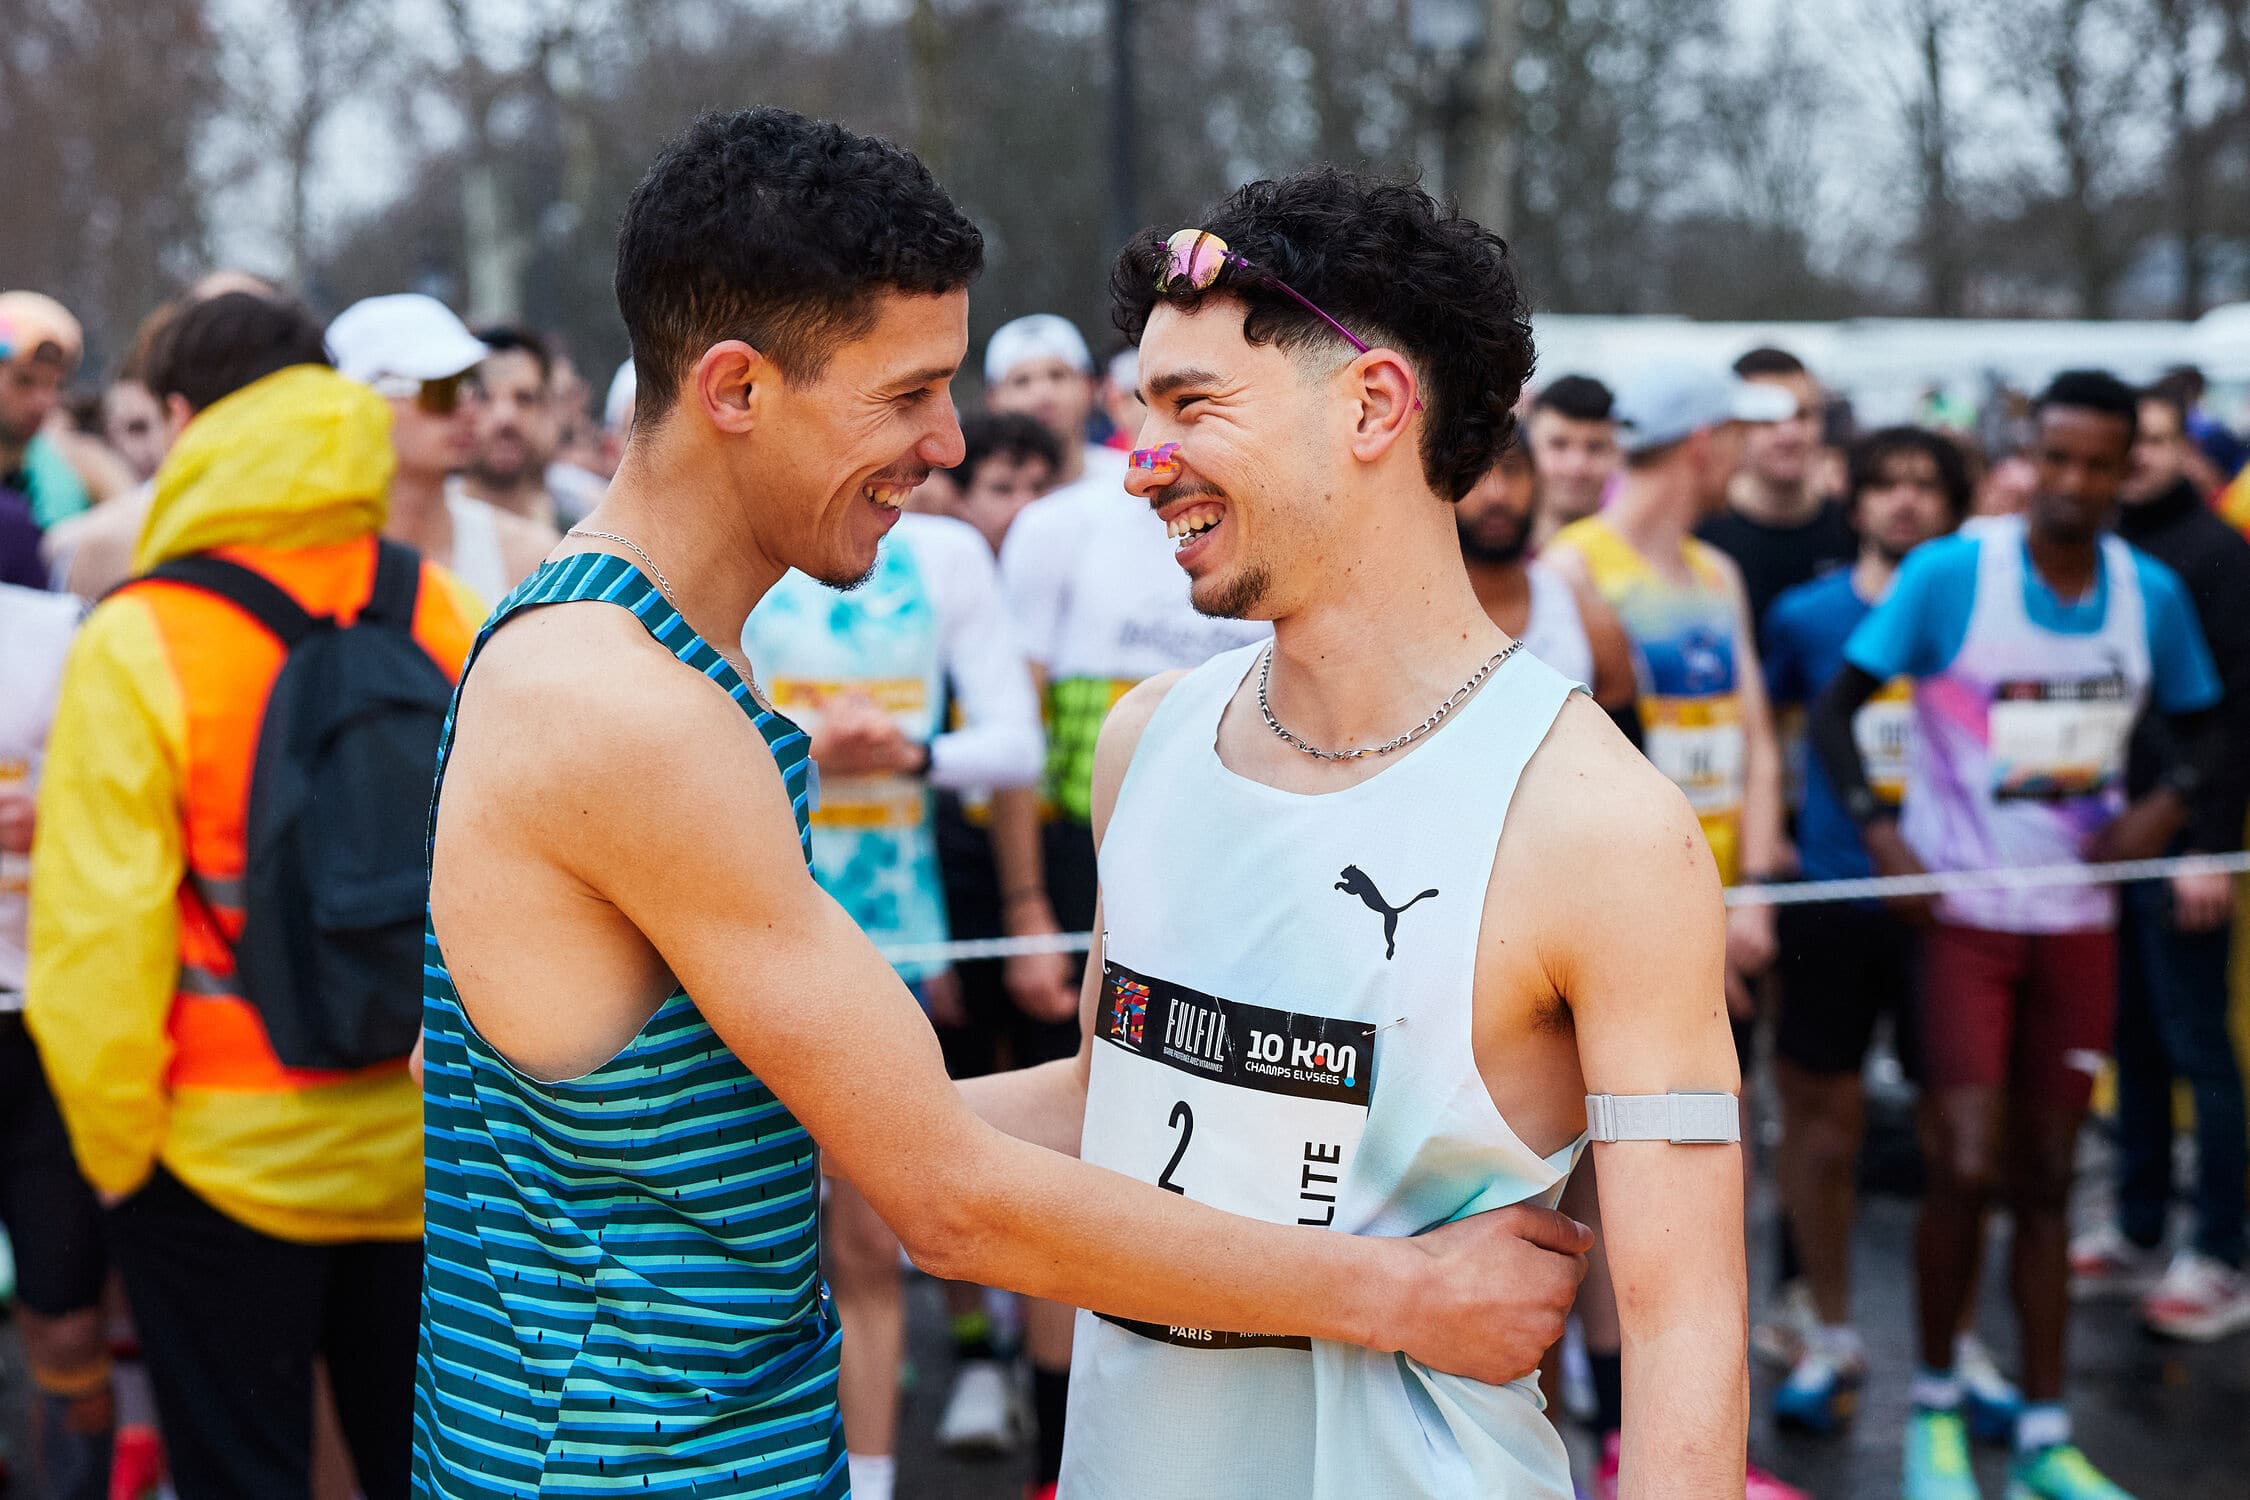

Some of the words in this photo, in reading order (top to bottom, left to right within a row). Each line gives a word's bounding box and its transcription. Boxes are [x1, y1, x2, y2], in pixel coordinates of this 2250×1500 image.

[1165, 998, 1226, 1062] FULFIL
[1247, 1030, 1284, 1063] 10
[1245, 1061, 1291, 1079] CHAMPS
[1293, 1070, 1340, 1086] ELYSÉES
[1158, 1100, 1194, 1196] 2
[1297, 1141, 1341, 1227] LITE
[1169, 1325, 1213, 1341] PARIS
